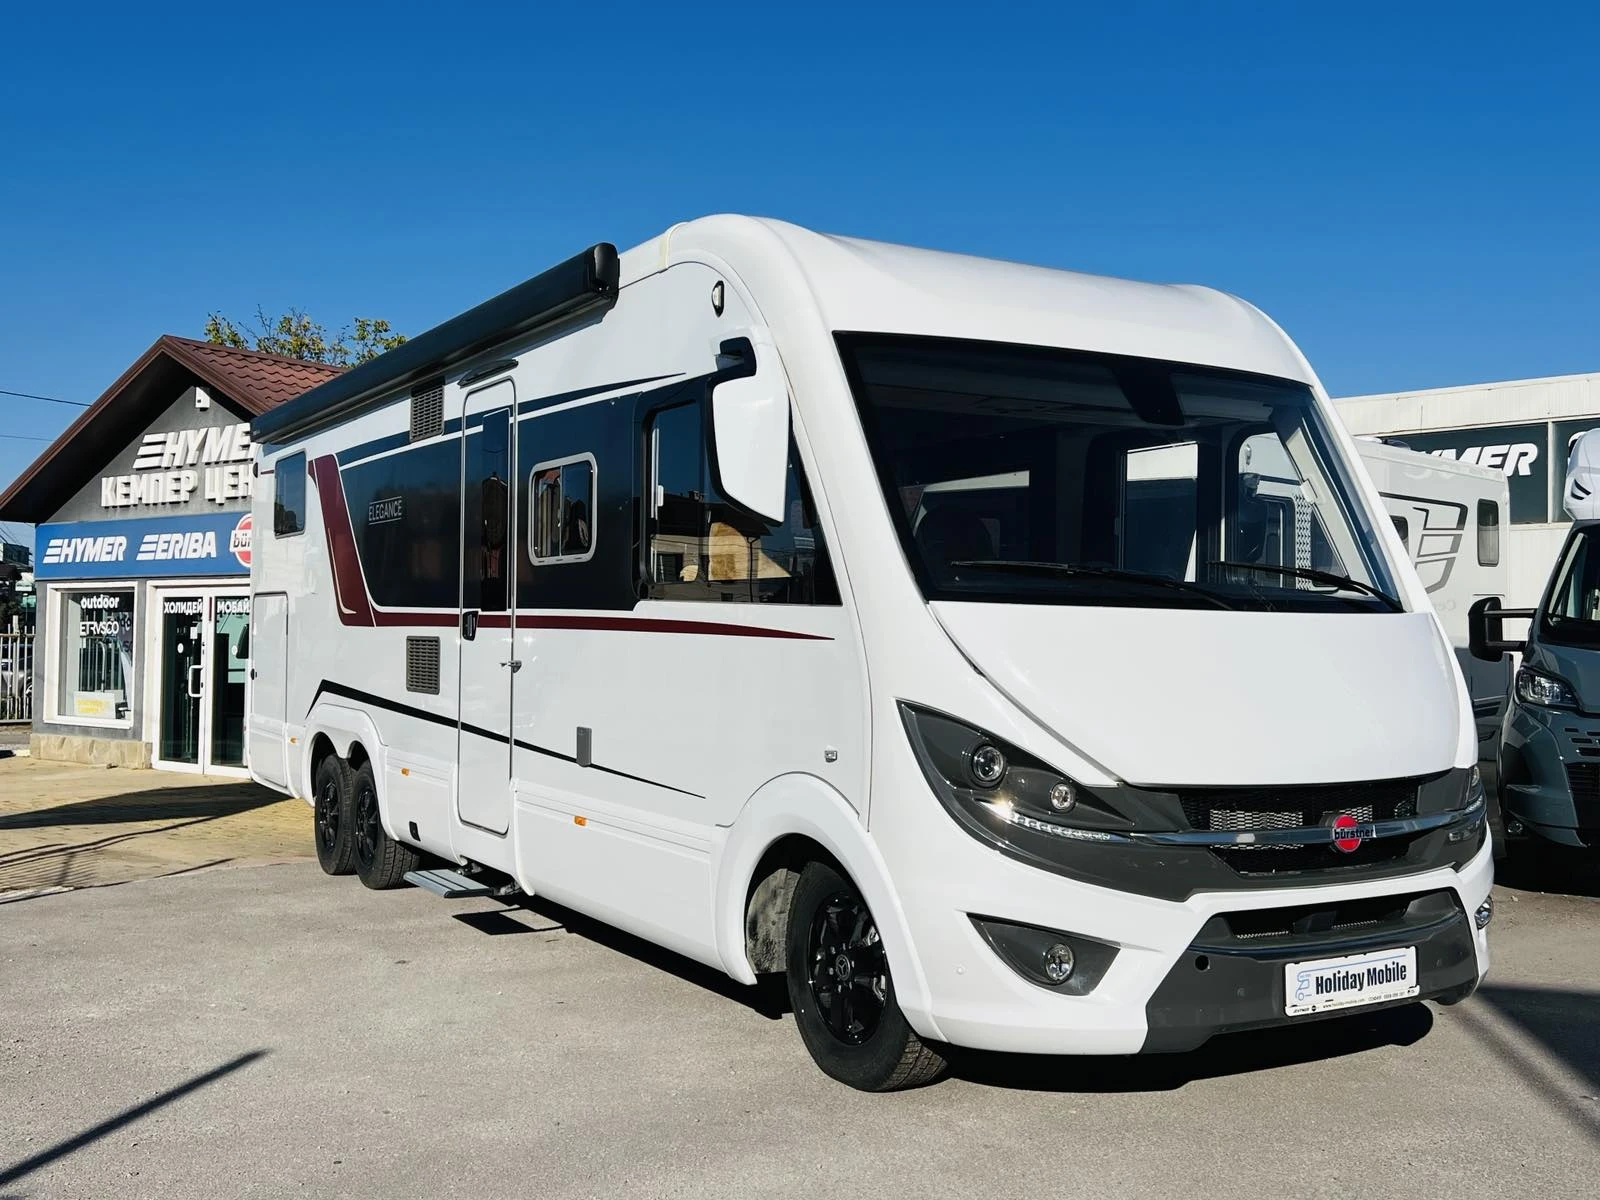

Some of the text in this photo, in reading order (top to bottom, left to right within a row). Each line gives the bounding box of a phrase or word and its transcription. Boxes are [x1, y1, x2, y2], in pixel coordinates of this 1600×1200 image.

[1409, 442, 1538, 477] MER
[101, 470, 198, 508] КЕМПЕР
[368, 500, 402, 521] ELEGANCE
[57, 535, 128, 563] HYMER
[156, 531, 217, 560] ERIBA
[80, 594, 120, 609] outdoor
[163, 598, 204, 616] ХОЛИДЕЙ
[1333, 827, 1374, 840] bürstner
[1315, 961, 1407, 995] Holiday Mobile
